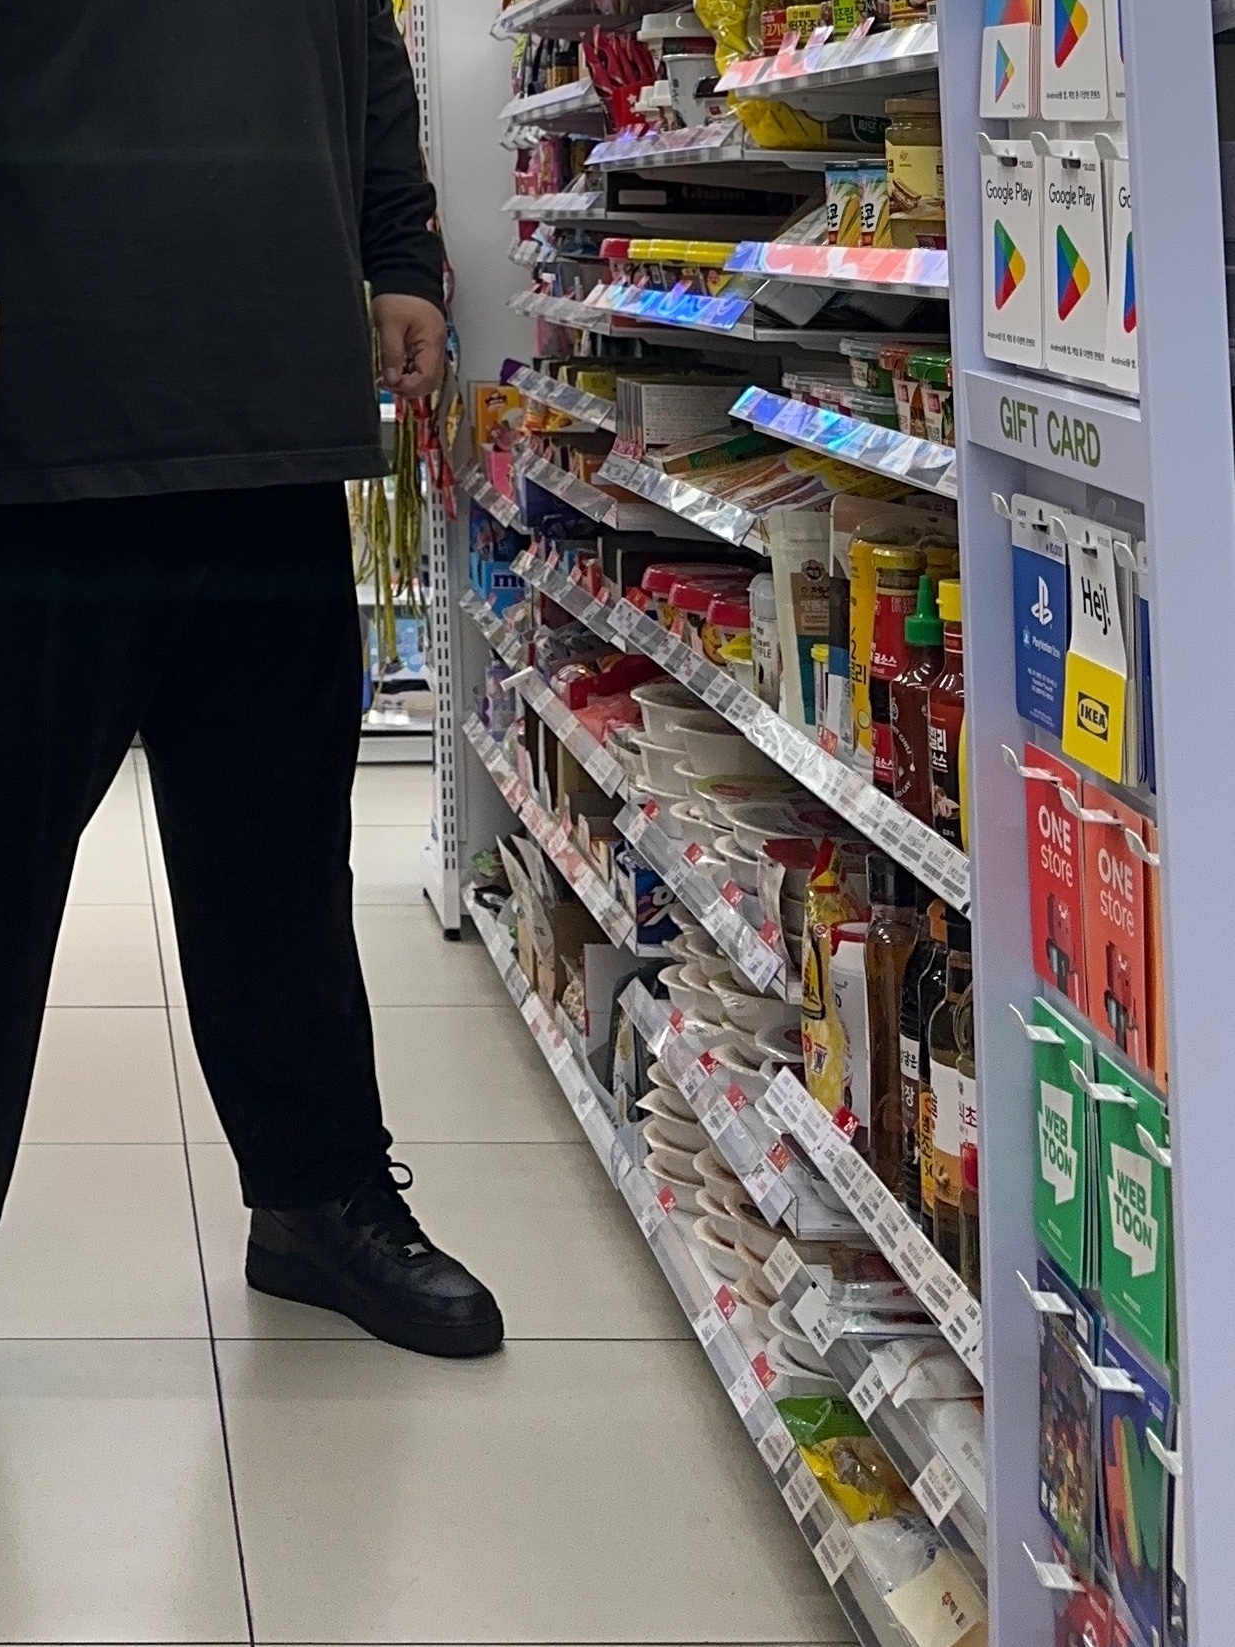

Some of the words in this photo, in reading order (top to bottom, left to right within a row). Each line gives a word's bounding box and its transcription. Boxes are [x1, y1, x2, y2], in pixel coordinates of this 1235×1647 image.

[985, 178, 1014, 206] Google
[1015, 181, 1033, 208] Play
[1048, 182, 1077, 211] Google
[1078, 185, 1096, 213] Play
[999, 395, 1039, 450] GIFT
[1046, 409, 1102, 469] CARD
[1080, 576, 1112, 636] Hej!
[1080, 702, 1107, 731] IKEA
[1037, 804, 1072, 857] ONE
[1040, 842, 1074, 889] store
[1097, 847, 1134, 905] ONE
[1099, 888, 1135, 939] store
[1044, 1104, 1068, 1149] WEB
[1041, 1127, 1073, 1180] TOON
[1116, 1168, 1147, 1217] WEB
[1113, 1191, 1153, 1252] TOON
